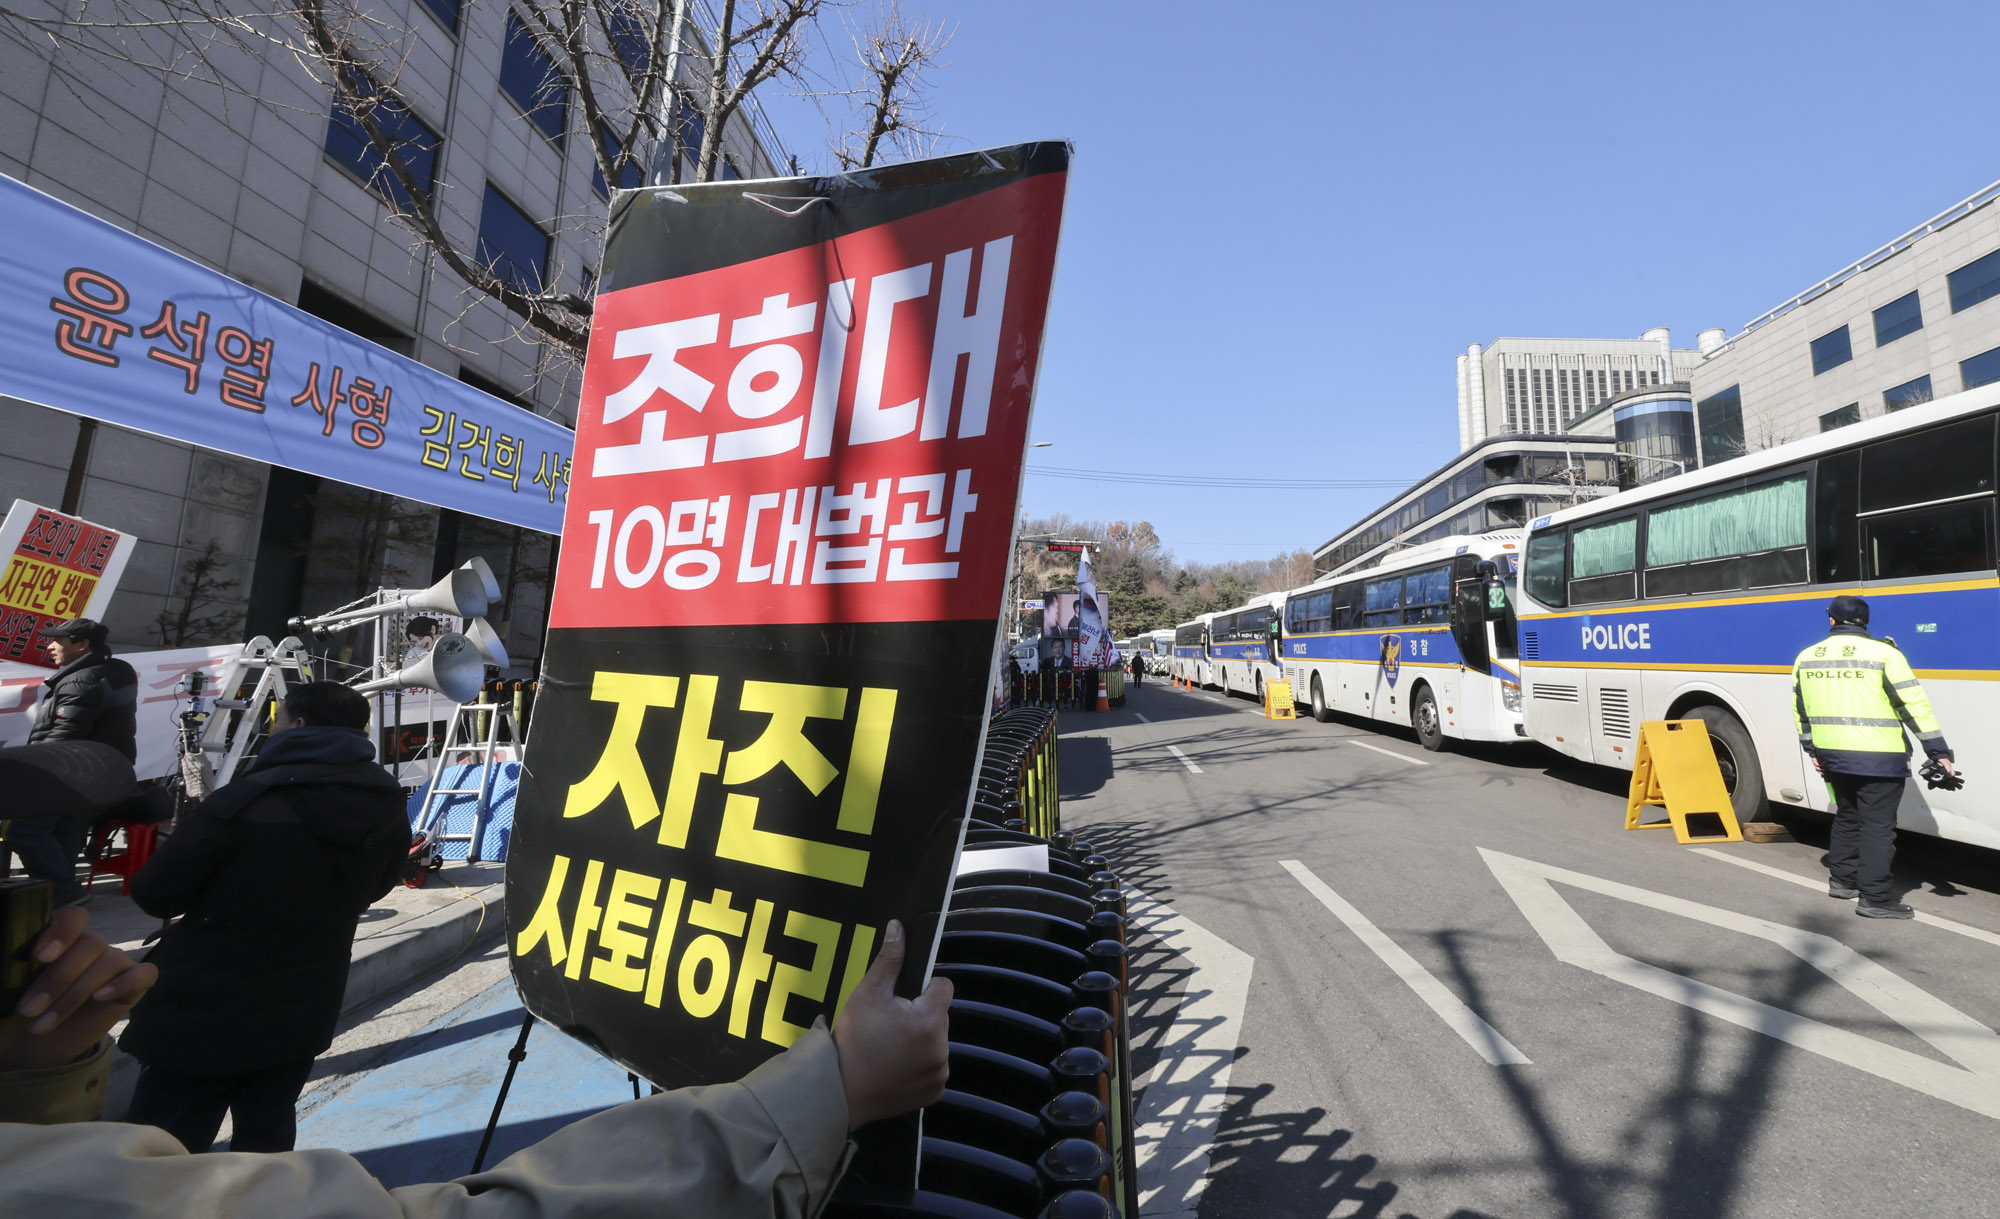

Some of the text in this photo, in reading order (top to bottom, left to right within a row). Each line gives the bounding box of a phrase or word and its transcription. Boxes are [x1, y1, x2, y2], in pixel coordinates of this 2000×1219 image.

[50, 267, 274, 414] 윤석열
[292, 362, 392, 449] 사형
[420, 404, 524, 491] 김건희
[592, 235, 1013, 478] 조희대
[20, 513, 116, 573] 조희대 사퇴
[588, 469, 978, 590] 10명 대법관
[0, 559, 97, 618] 지귀연 방빼
[1489, 588, 1505, 608] 32
[0, 609, 39, 657] 석열
[1293, 643, 1307, 655] POLICE
[1582, 623, 1651, 650] POLICE
[1806, 671, 1865, 679] POLICE
[563, 671, 898, 888] 자진
